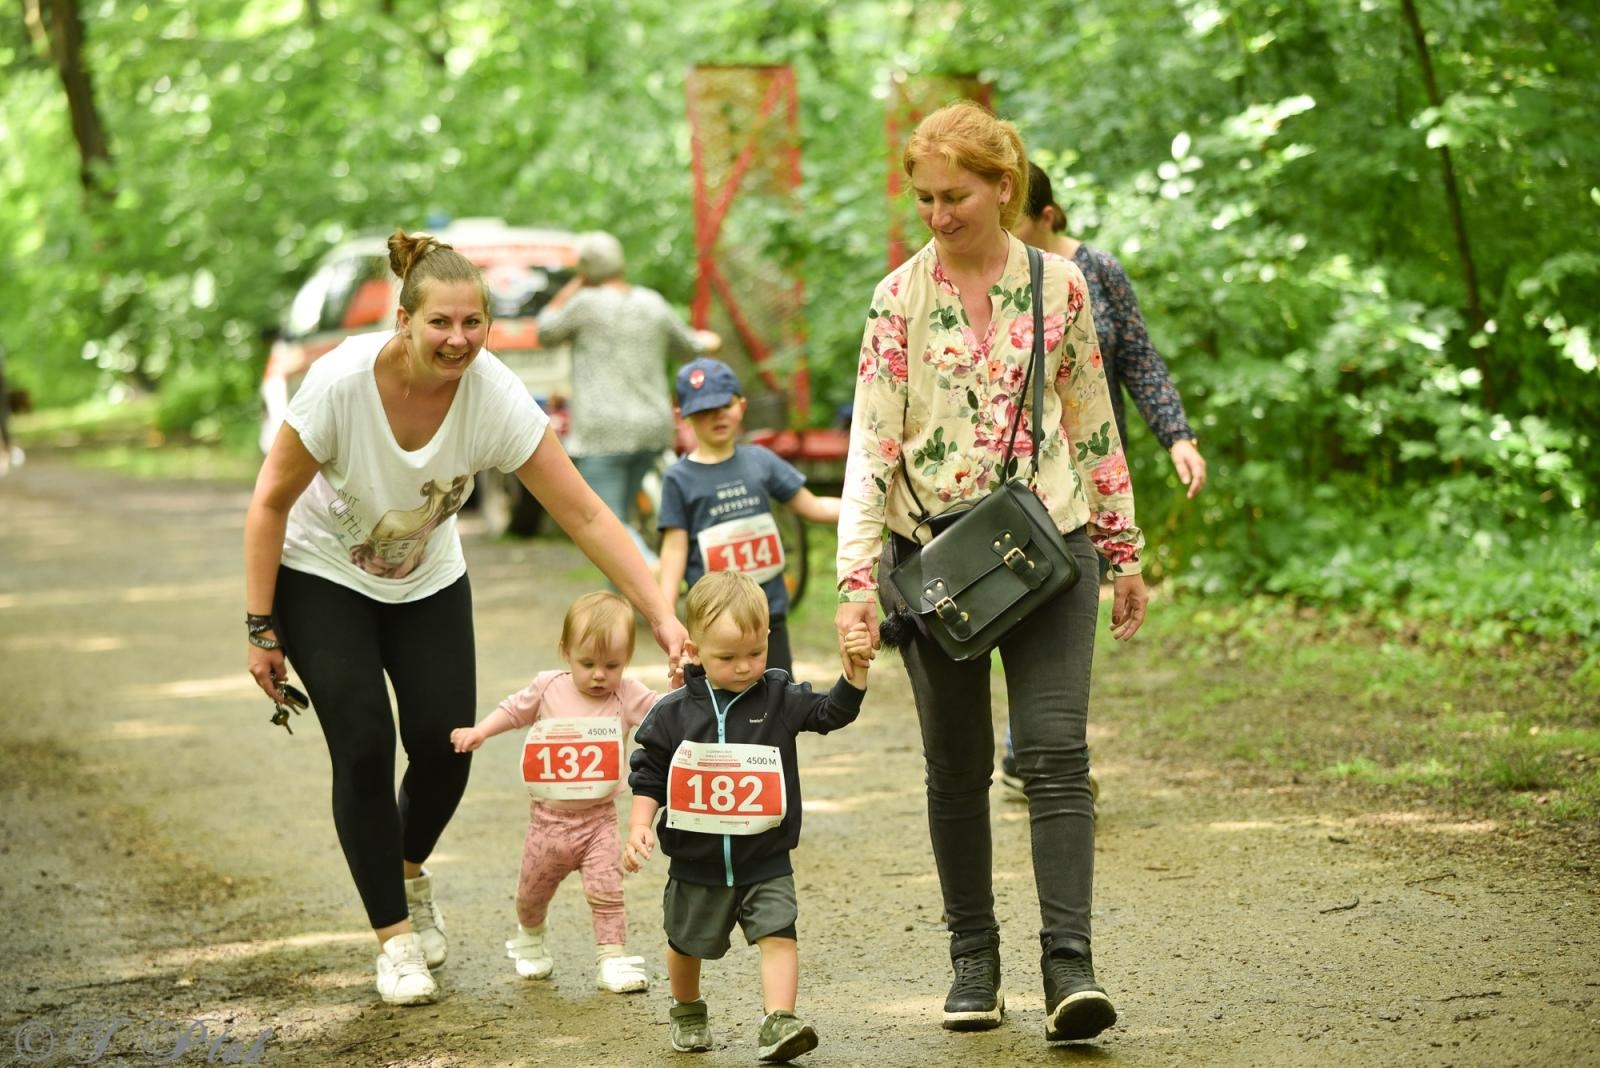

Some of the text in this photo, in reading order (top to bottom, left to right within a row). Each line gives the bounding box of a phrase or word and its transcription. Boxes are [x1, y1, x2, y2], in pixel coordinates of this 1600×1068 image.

[720, 538, 773, 572] 114
[587, 728, 607, 736] 4500
[536, 745, 605, 780] 132
[746, 757, 767, 765] 4500
[769, 758, 777, 766] M
[686, 774, 763, 812] 182
